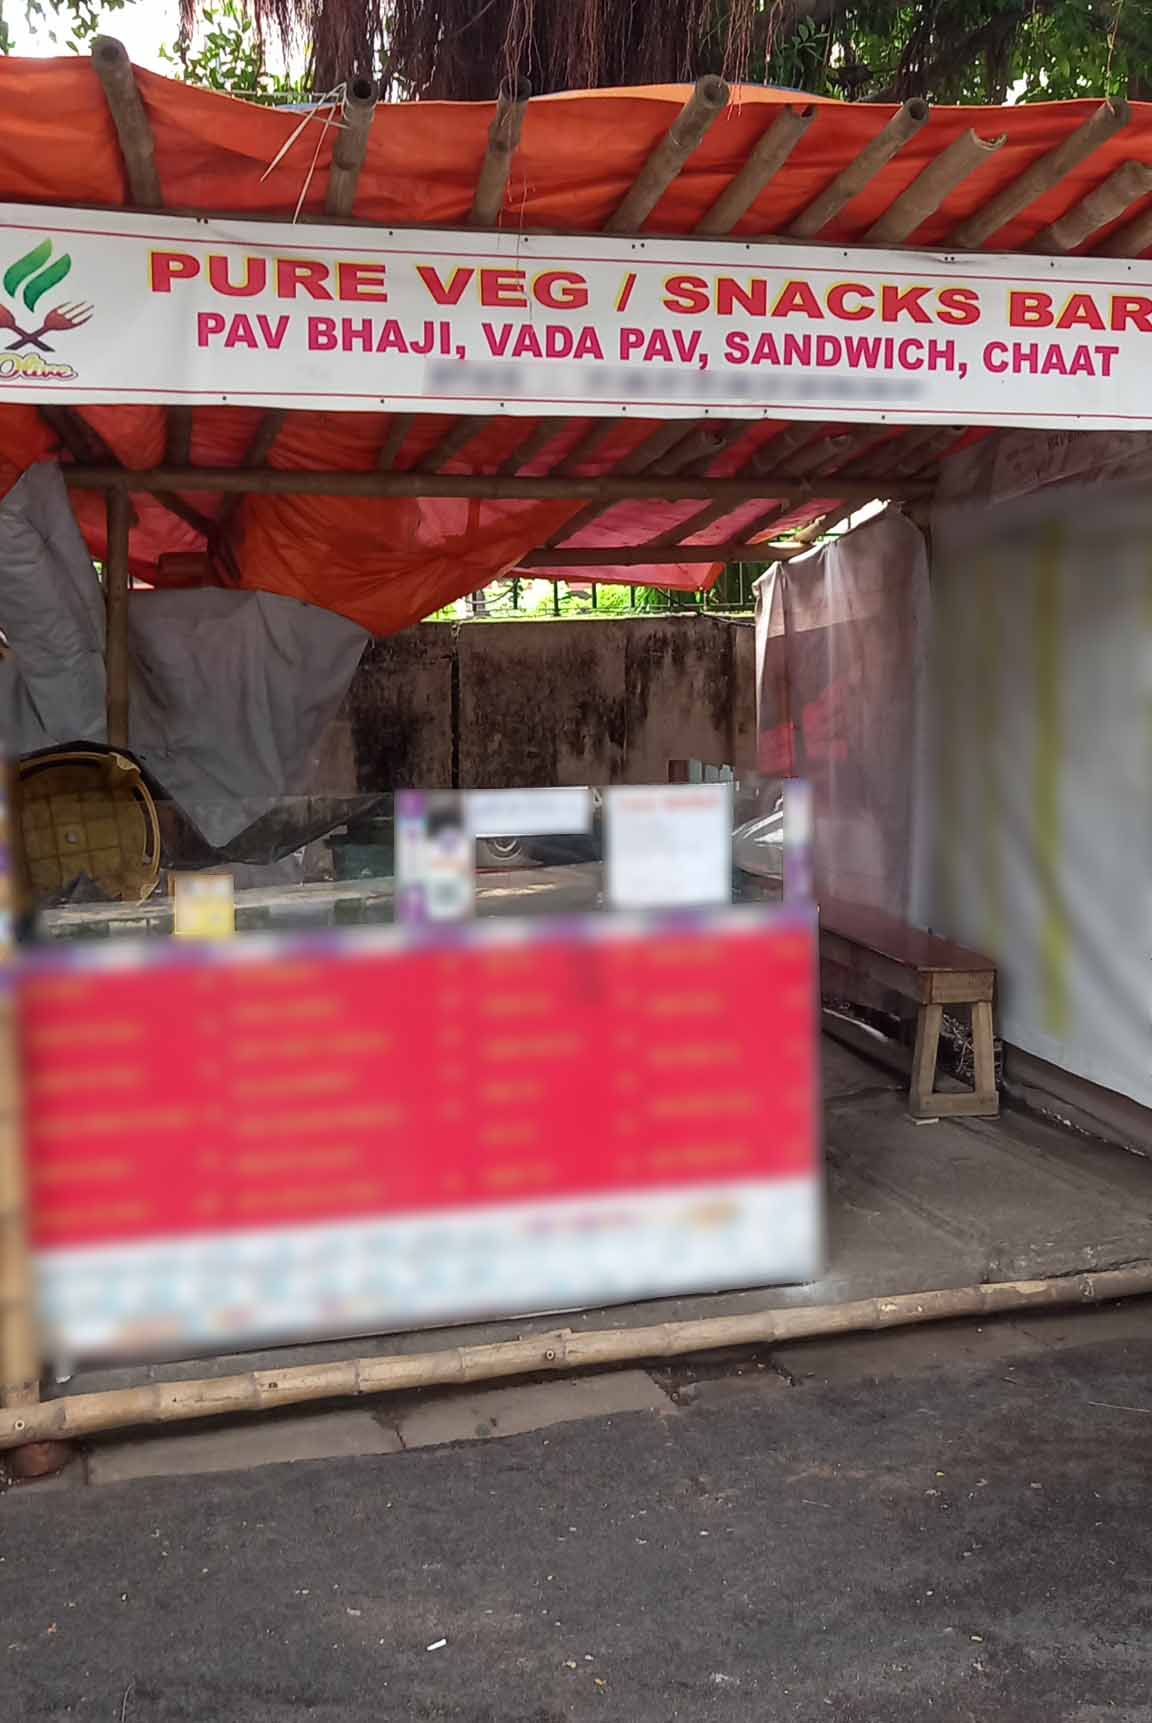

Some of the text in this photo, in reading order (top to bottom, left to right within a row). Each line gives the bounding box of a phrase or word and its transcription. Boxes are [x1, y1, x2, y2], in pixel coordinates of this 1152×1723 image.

[149, 250, 1152, 334] PURE VEG / SNACKS BAR
[197, 312, 1121, 379] PAV BHAJI, VADA PAV, SANDWICH, CHAAT
